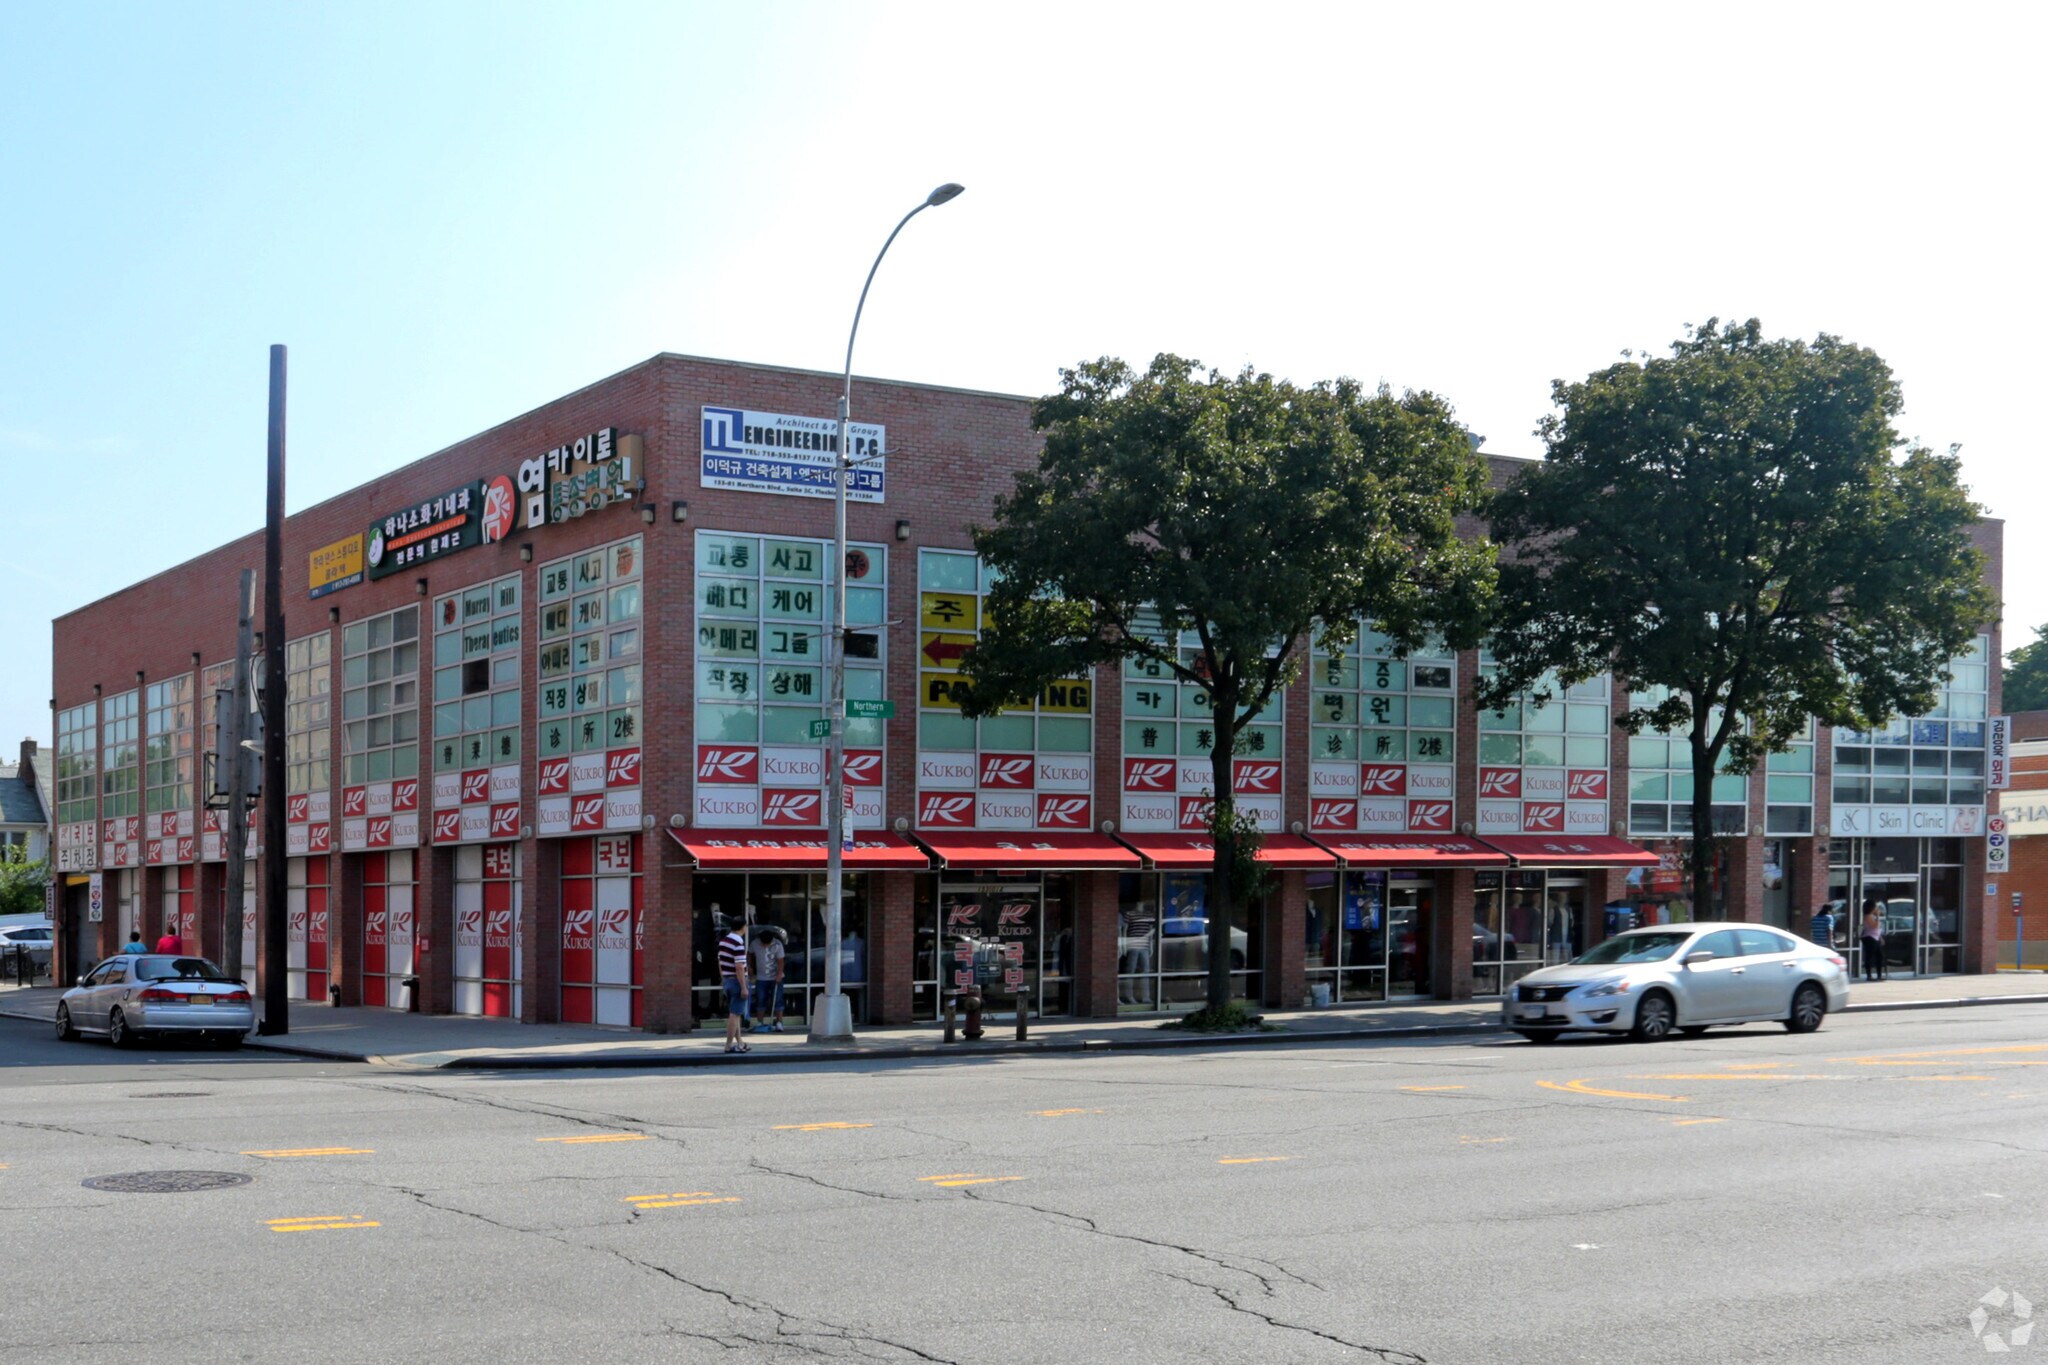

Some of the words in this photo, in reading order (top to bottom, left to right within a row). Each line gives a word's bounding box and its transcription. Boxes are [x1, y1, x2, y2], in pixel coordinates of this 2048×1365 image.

[776, 417, 819, 430] Architect
[821, 422, 828, 431] &
[851, 426, 879, 437] Group
[744, 425, 850, 453] ENGINEERIN
[745, 448, 760, 456] TEL:
[706, 458, 742, 475] 이덕규
[859, 474, 881, 488] 그룹
[815, 488, 836, 497] Flushin
[385, 488, 471, 538] 하나소화기내과
[708, 544, 749, 568] 교통
[772, 549, 812, 572] 사고
[500, 586, 515, 607] Hill
[706, 585, 747, 609] 메디
[772, 589, 812, 613] 케어
[699, 627, 757, 651] 아메리
[771, 672, 812, 695] 상해
[929, 680, 1088, 708] PAING
[853, 701, 884, 711] Northern
[573, 766, 604, 781] KUKBO
[764, 758, 820, 776] KUKBO
[922, 762, 974, 778] KUKBO
[1040, 765, 1088, 781] KUKBO
[1313, 771, 1355, 786] KUKBO
[1411, 774, 1450, 788] KUKBO
[1526, 777, 1563, 791] KUKBO
[540, 809, 569, 824] KUKBO
[608, 802, 641, 818] KUKBO
[700, 798, 757, 815] KUKBO
[981, 803, 1031, 818] KUKBO
[1127, 805, 1173, 820] KUKBO
[1362, 808, 1403, 822] KUKBO
[1481, 810, 1518, 823] KUKBO
[1568, 811, 1604, 823] KUKBO
[1879, 812, 1902, 828] Skin
[1913, 812, 1944, 829] Clinic
[486, 848, 511, 874] 국보
[600, 840, 629, 868] 국보
[947, 926, 982, 936] KUKBO
[998, 925, 1032, 935] KUKBO
